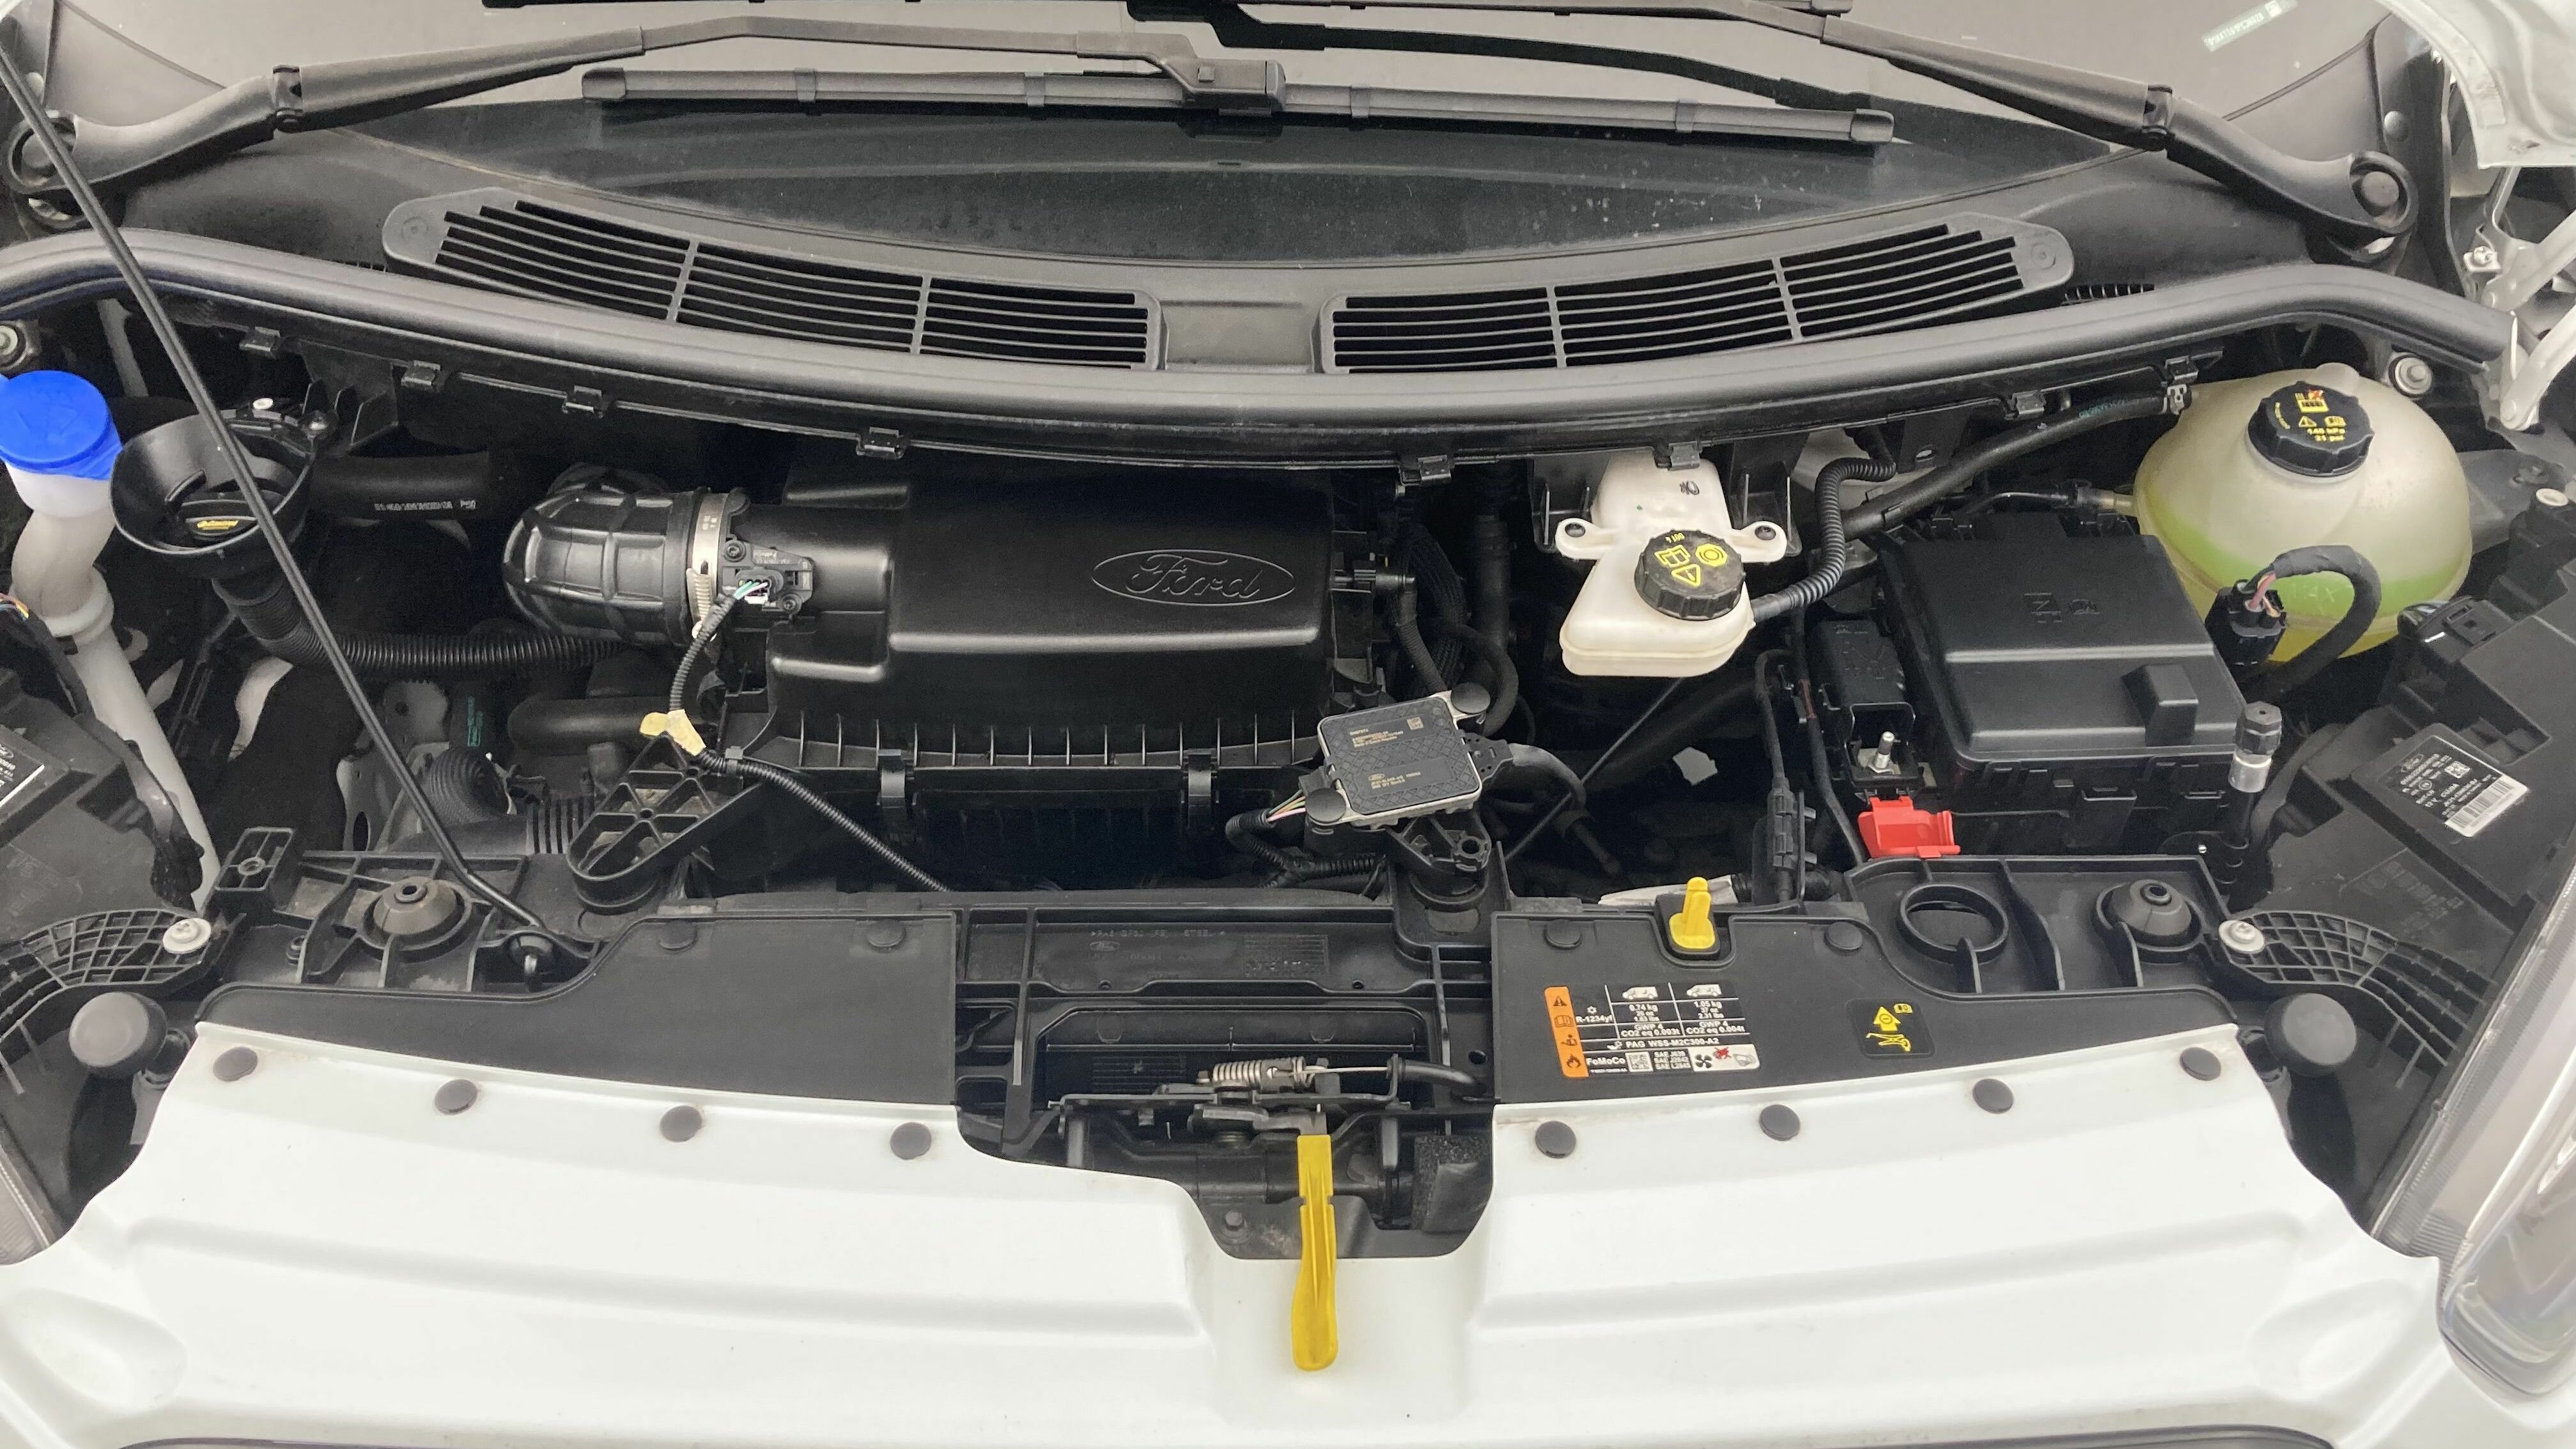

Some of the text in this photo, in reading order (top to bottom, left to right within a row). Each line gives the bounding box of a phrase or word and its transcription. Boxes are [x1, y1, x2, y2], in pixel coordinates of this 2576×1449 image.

[1125, 554, 1264, 600] Ford
[1647, 1003, 1658, 1012] kg
[1711, 1000, 1723, 1009] kg
[1576, 1015, 1613, 1023] R-1234yf
[1647, 1037, 1719, 1048] WSS-M2C300-A2
[1586, 1057, 1626, 1065] FoMoCo
